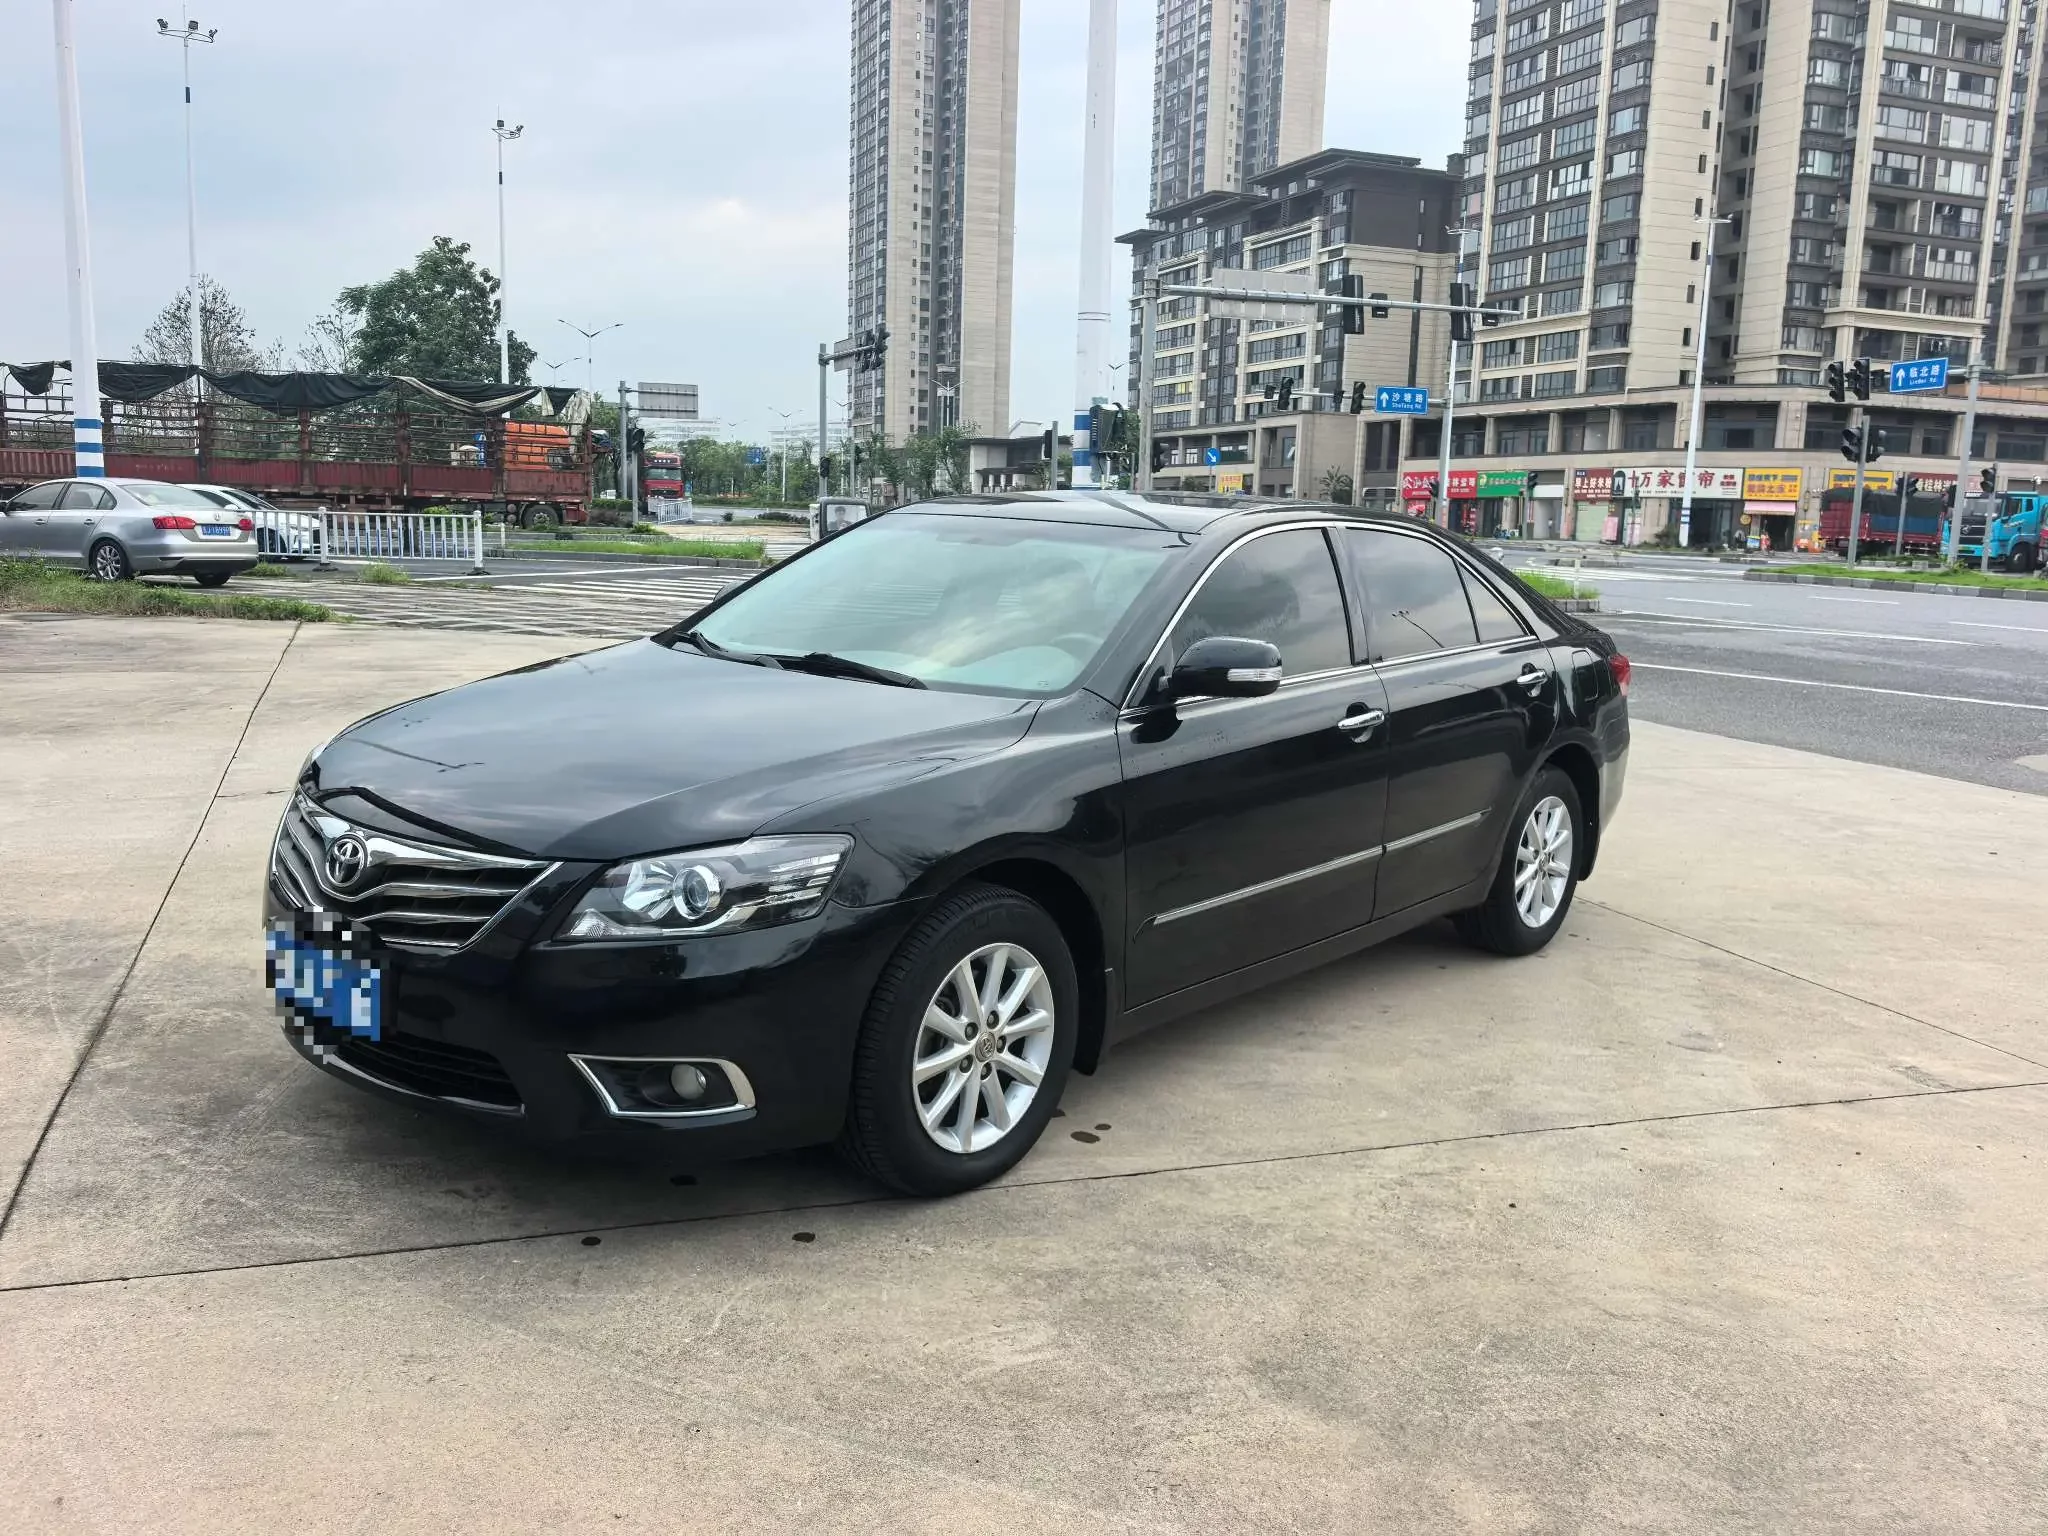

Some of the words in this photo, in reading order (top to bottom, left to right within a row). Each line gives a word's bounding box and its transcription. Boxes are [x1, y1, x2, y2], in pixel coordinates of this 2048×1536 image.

[1909, 364, 1940, 378] 临北路
[1391, 391, 1423, 403] 沙塘路
[1575, 476, 1612, 488] 早上好米粉
